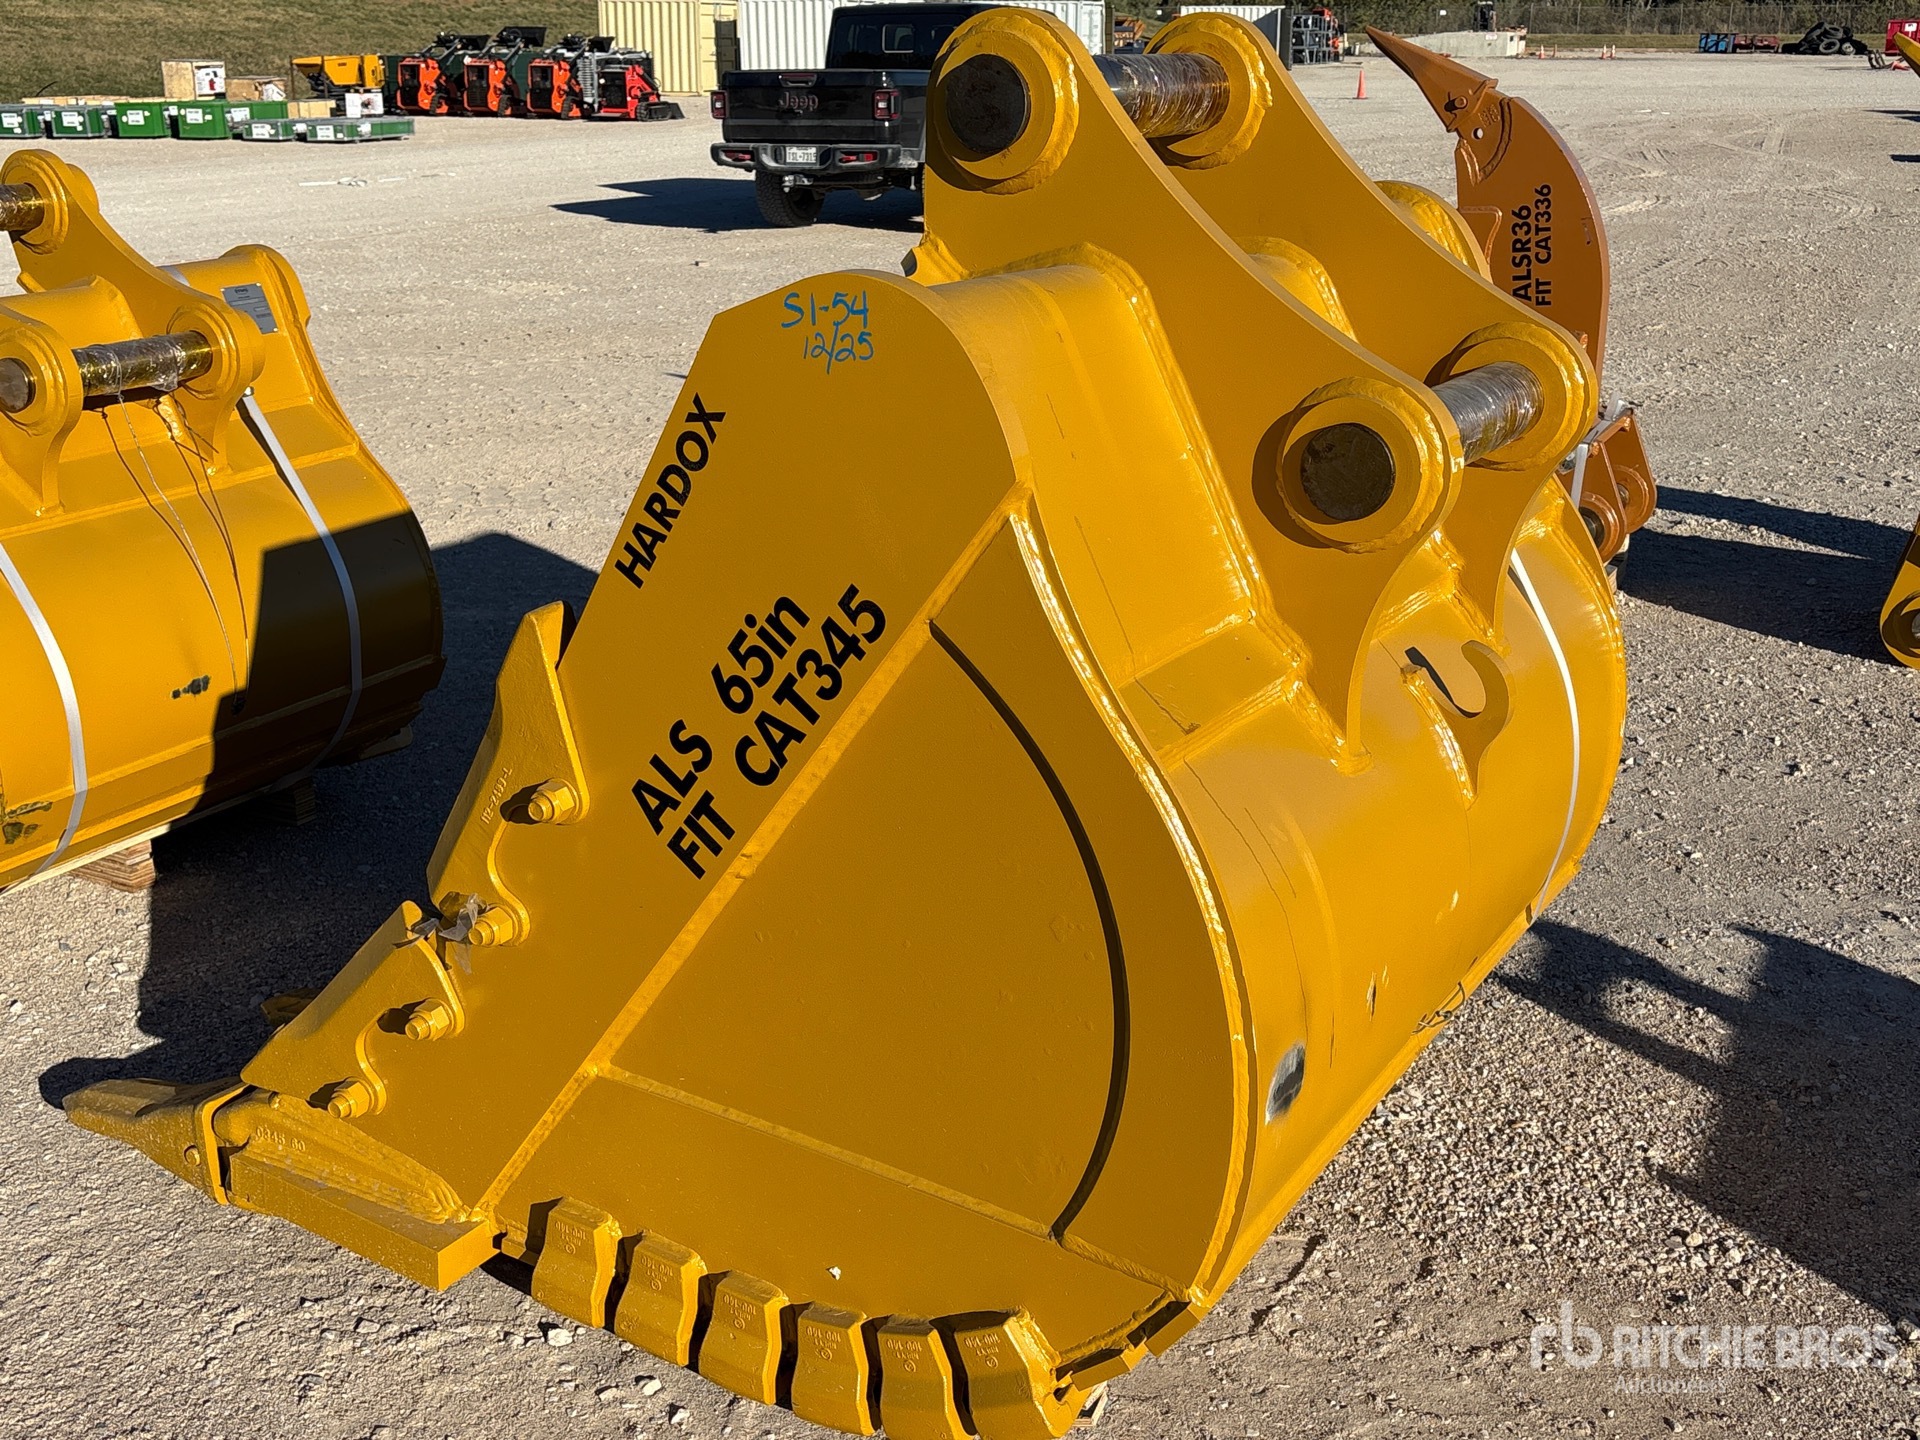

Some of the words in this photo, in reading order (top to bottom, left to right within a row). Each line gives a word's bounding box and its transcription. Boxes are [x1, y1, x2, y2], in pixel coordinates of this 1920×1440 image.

[778, 91, 819, 111] Jeep
[1511, 204, 1532, 302] ALSR36
[1534, 184, 1552, 265] CAT336
[1535, 277, 1552, 307] FIT
[803, 320, 875, 376] 12/25
[614, 391, 727, 590] HARDOX
[631, 718, 713, 837] ALS
[710, 595, 811, 715] 65in
[666, 789, 736, 881] FIT
[734, 582, 887, 788] CAT345
